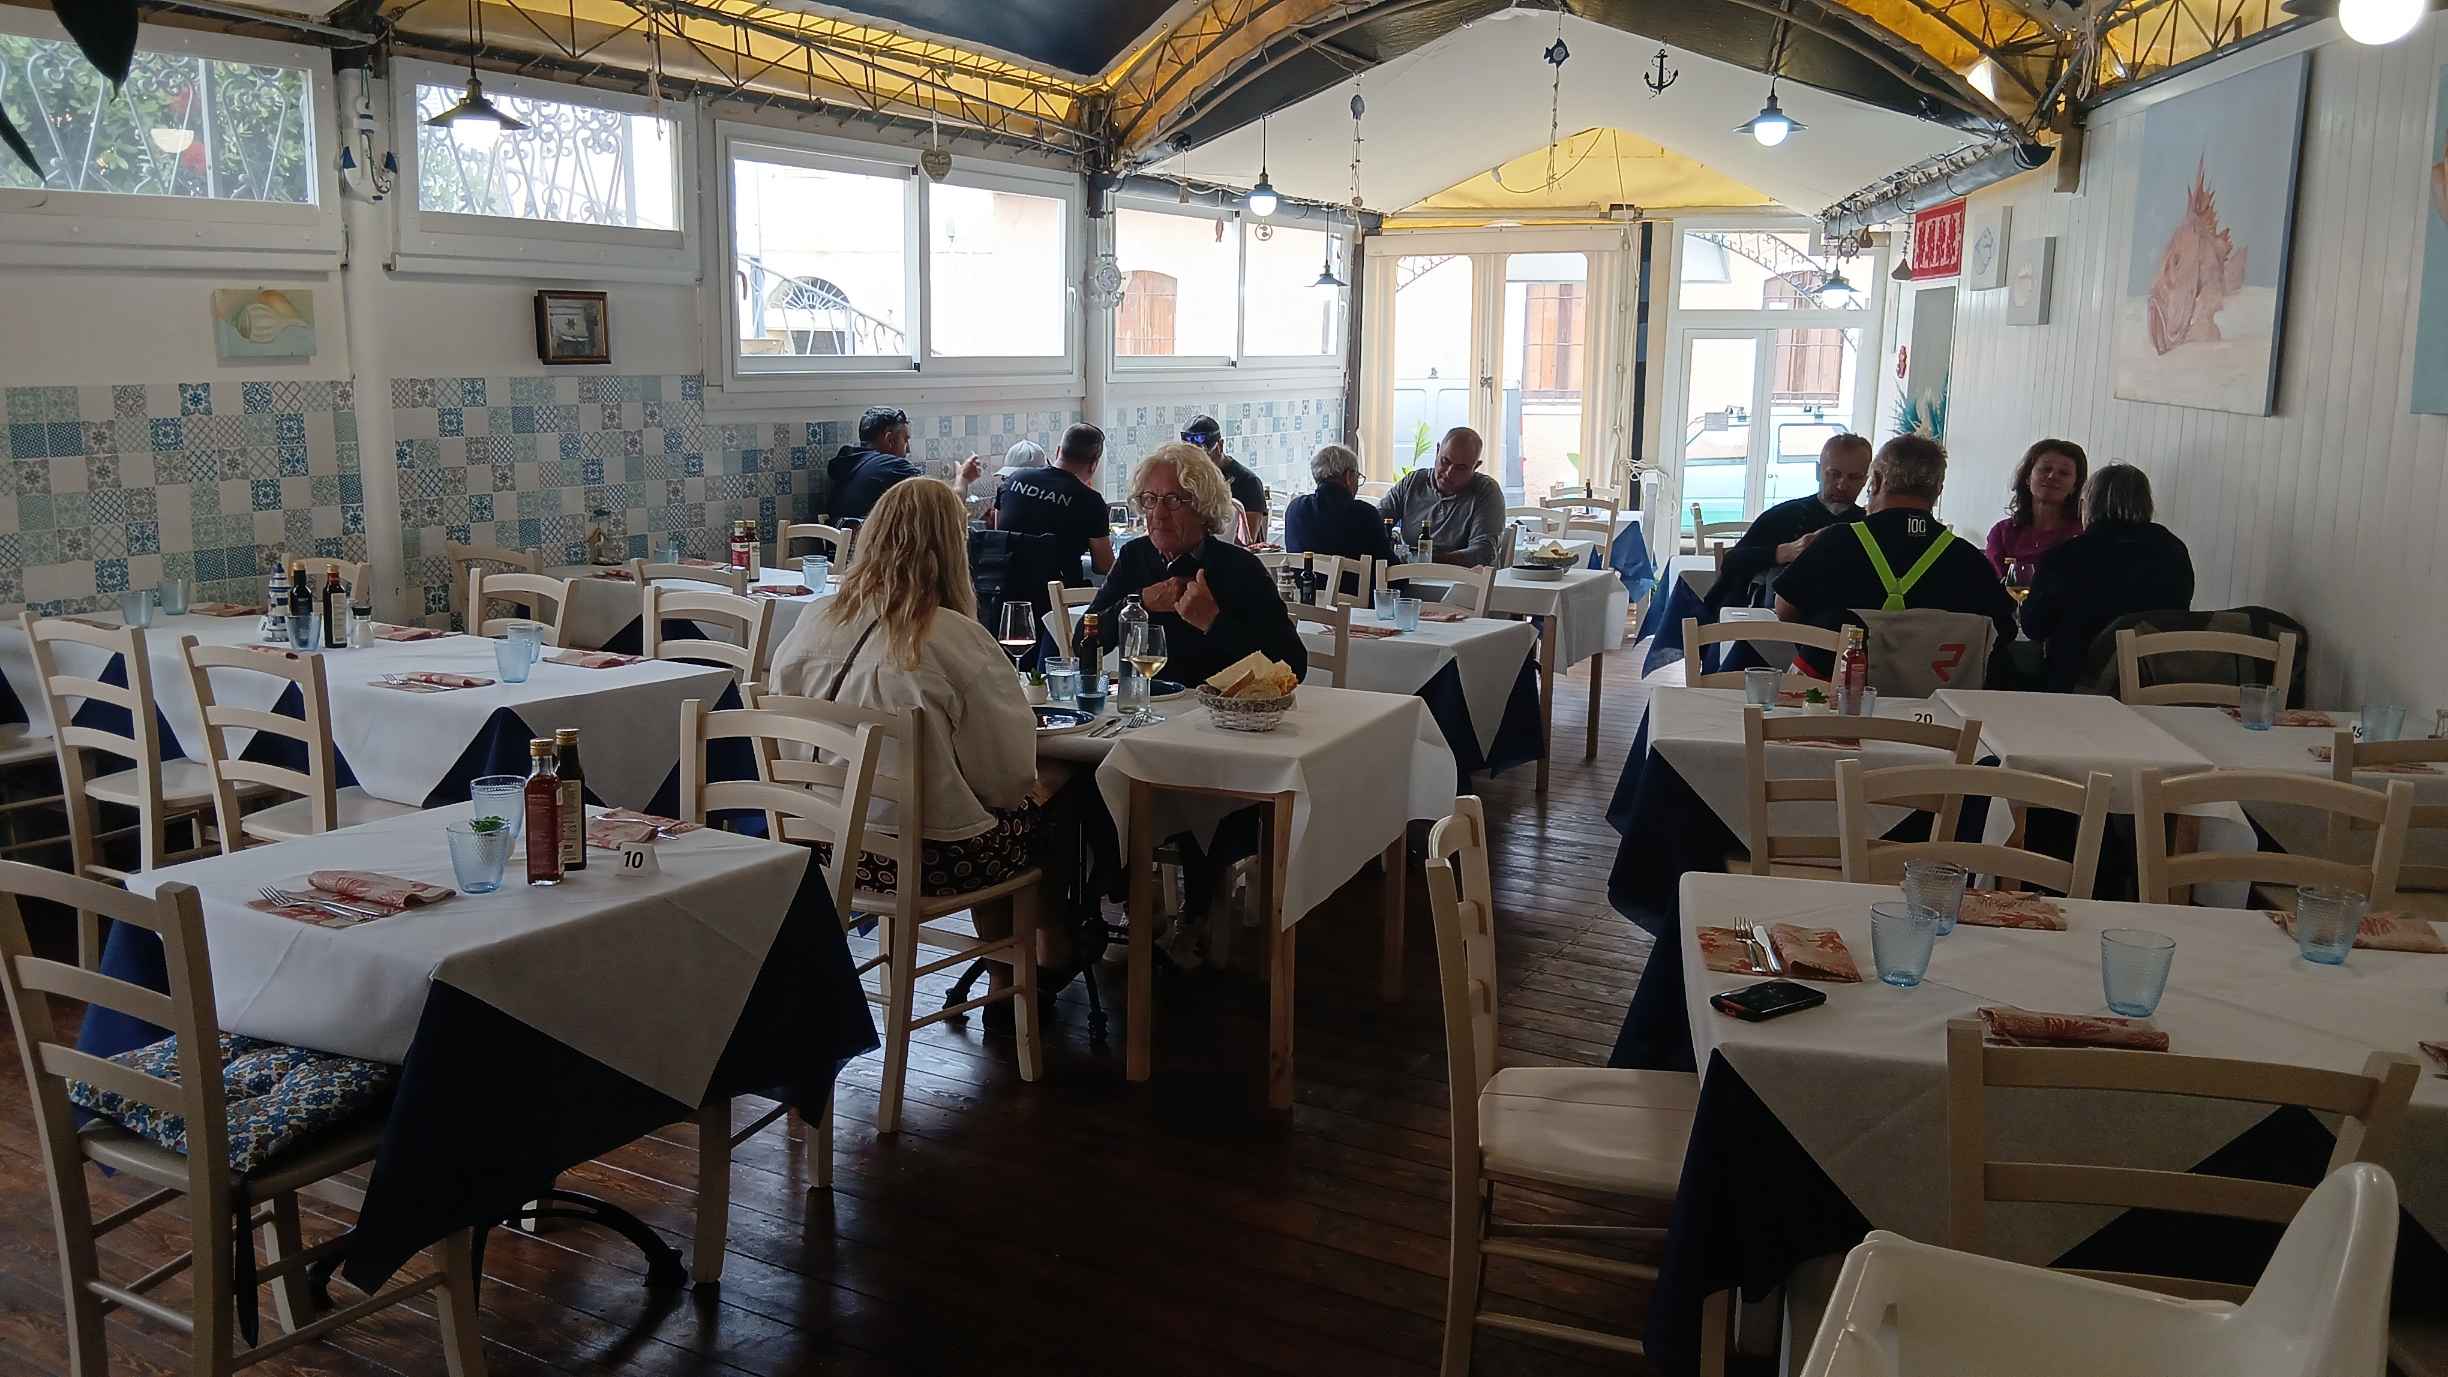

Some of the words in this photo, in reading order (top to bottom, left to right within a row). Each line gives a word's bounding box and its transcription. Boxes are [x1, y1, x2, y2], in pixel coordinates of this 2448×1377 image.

[1010, 480, 1072, 507] INDIAN
[1907, 518, 1926, 533] 100
[1914, 712, 1933, 724] 20
[624, 850, 644, 869] 10
